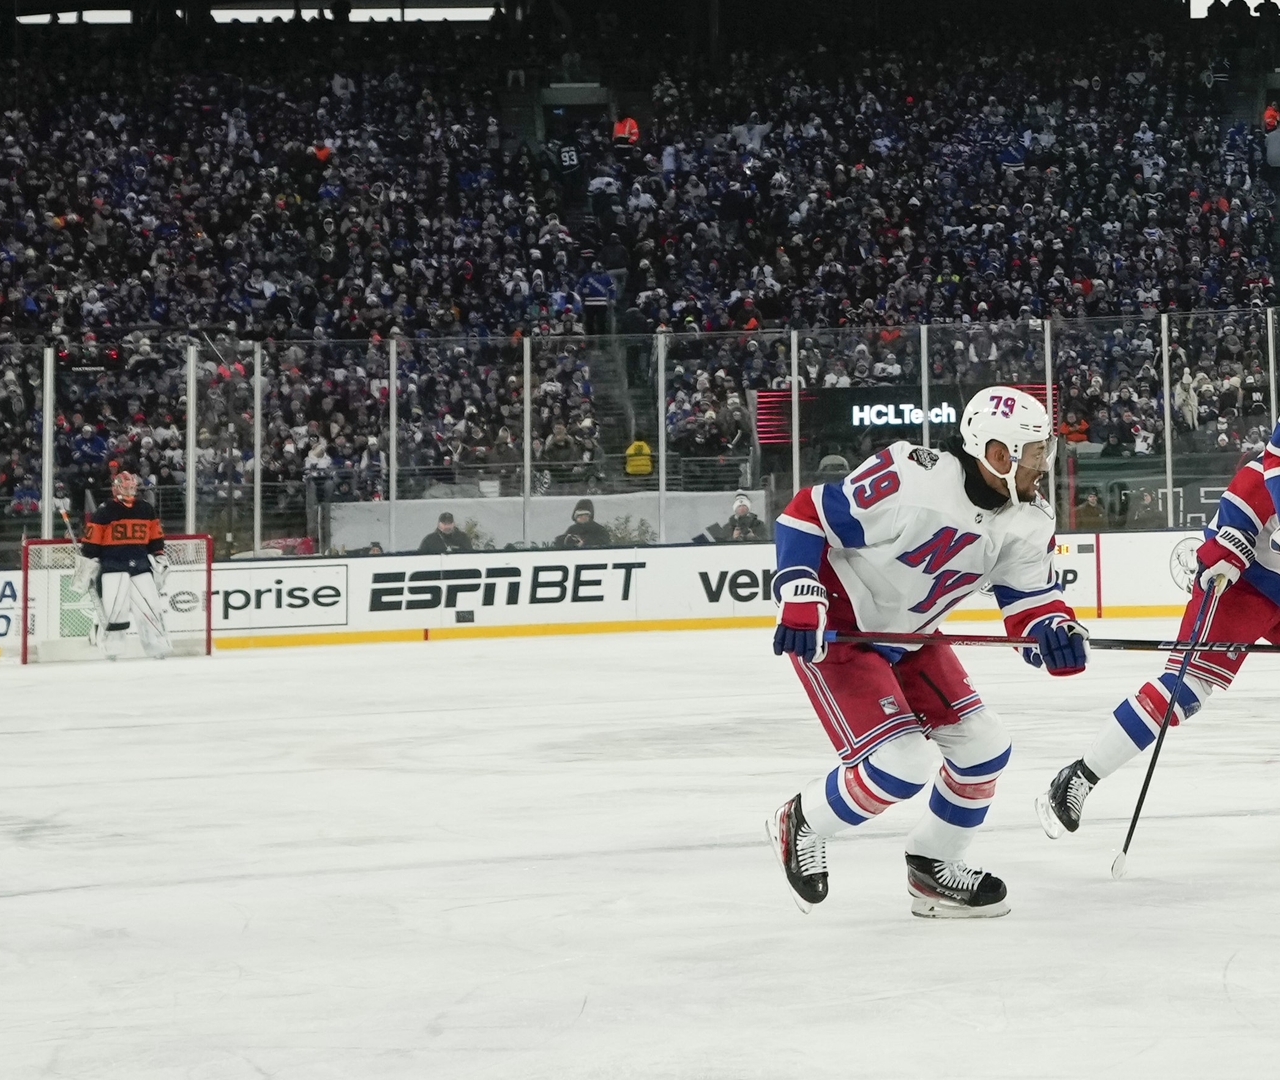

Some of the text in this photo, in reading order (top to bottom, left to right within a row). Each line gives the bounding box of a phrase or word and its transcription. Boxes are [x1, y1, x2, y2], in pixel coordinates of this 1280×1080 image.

[851, 402, 956, 426] HCLTech
[989, 395, 1017, 419] 79
[851, 448, 901, 510] 79
[111, 523, 148, 541] ISLES
[369, 561, 647, 612] ESPN BET
[1158, 640, 1247, 652] BAUER
